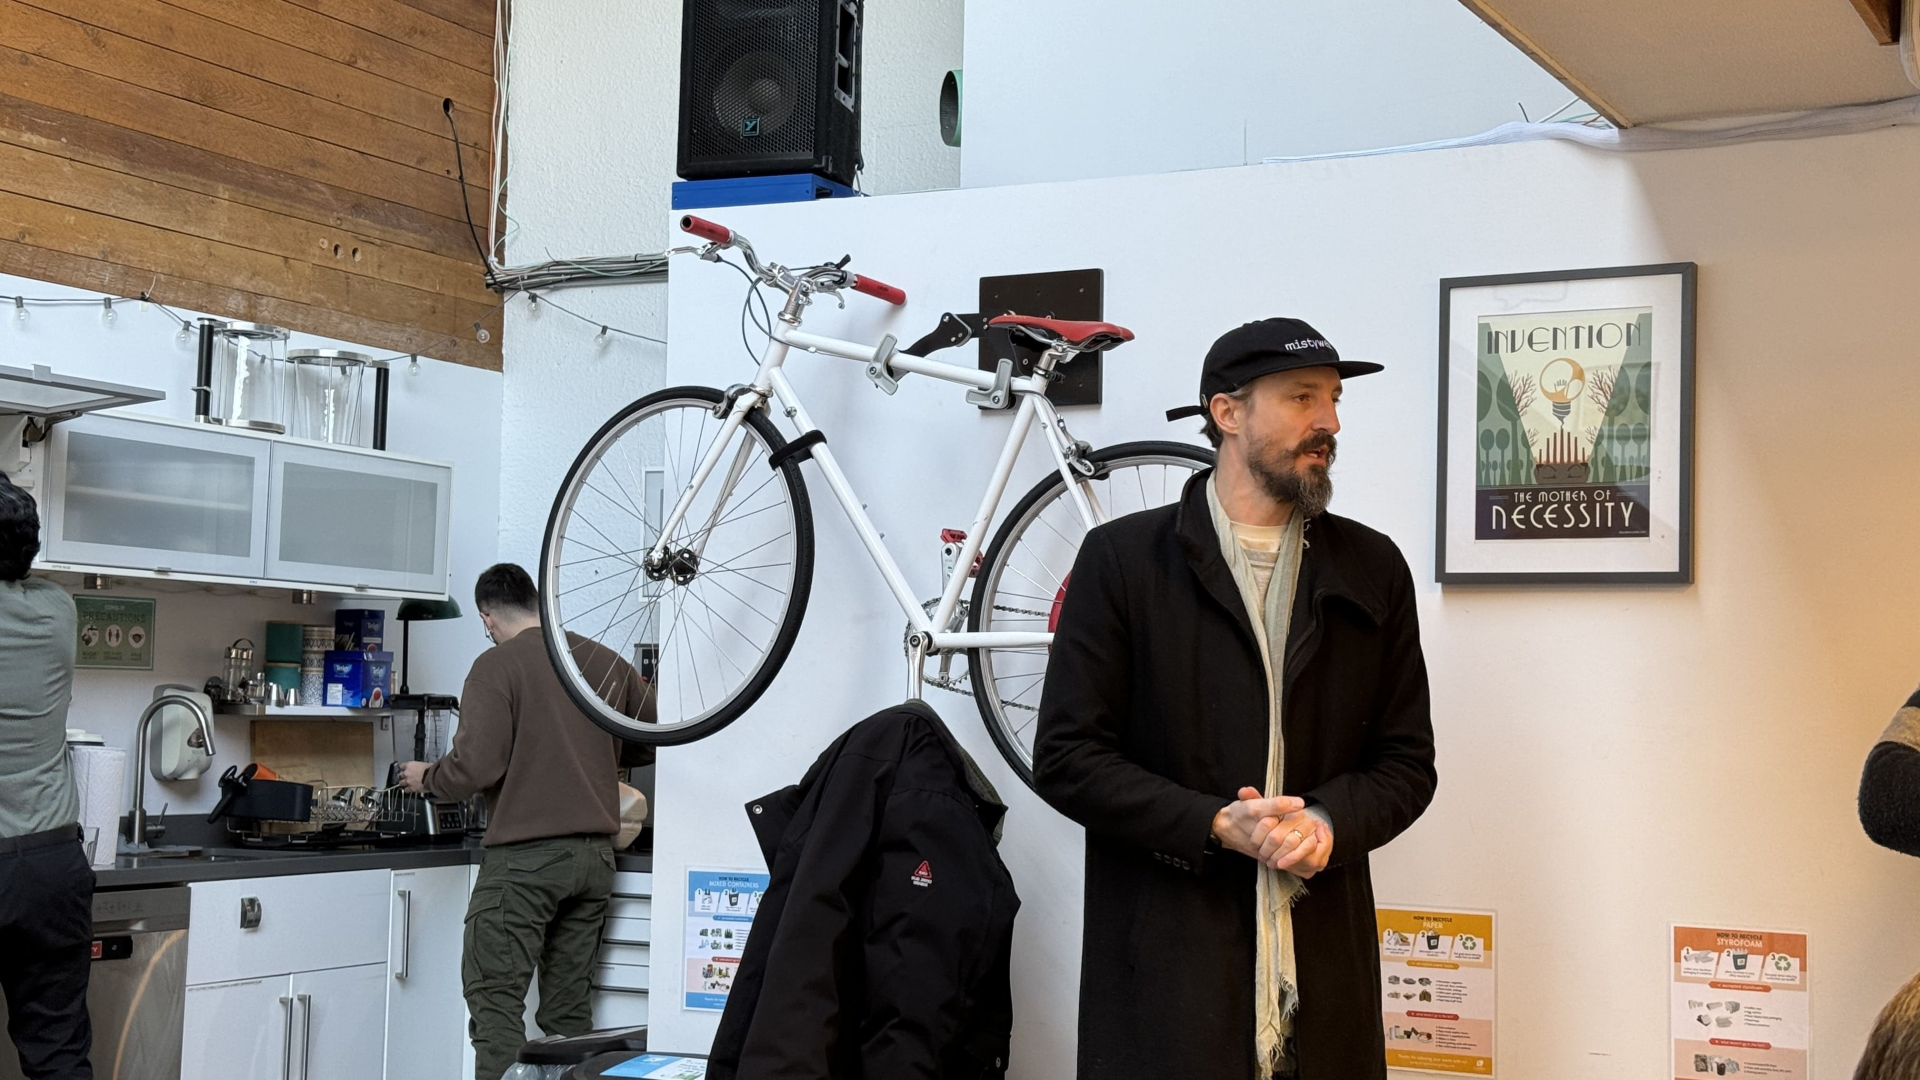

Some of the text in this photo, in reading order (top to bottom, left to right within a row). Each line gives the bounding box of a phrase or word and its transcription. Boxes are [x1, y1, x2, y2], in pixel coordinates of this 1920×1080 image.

[1487, 322, 1641, 354] INVENTION
[1514, 490, 1611, 503] THE MOTHER OF
[1492, 502, 1634, 530] NECESSITY
[83, 611, 146, 623] PRECAUTIONS
[727, 881, 760, 889] CONTAINERS
[1422, 921, 1443, 929] PAPER
[1716, 939, 1763, 948] STYROFOAM
